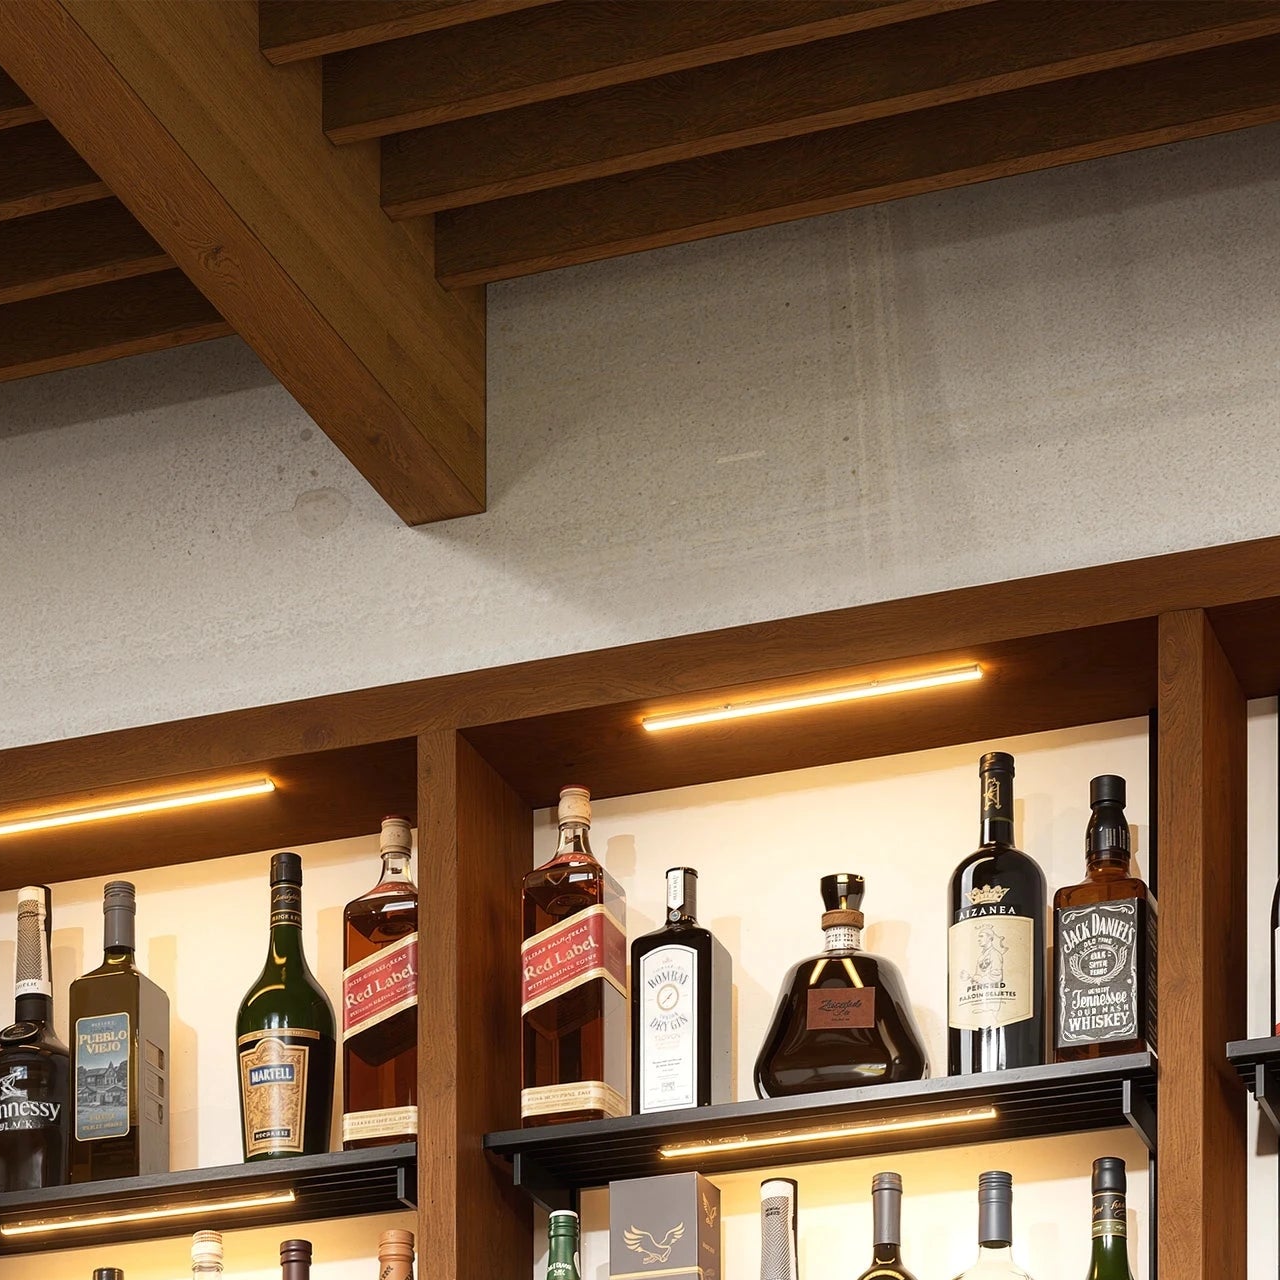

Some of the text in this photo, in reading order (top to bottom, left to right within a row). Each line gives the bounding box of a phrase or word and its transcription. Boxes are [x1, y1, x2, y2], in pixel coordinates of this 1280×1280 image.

[1063, 922, 1090, 952] JACK
[523, 935, 599, 982] Red Label
[345, 966, 414, 1010] Red Label
[1071, 991, 1128, 1009] Tennessee
[1068, 1012, 1130, 1031] WHISKEY
[79, 1031, 127, 1048] PUEBLO
[86, 1042, 121, 1055] VIEJO
[251, 1067, 292, 1083] MARTELL
